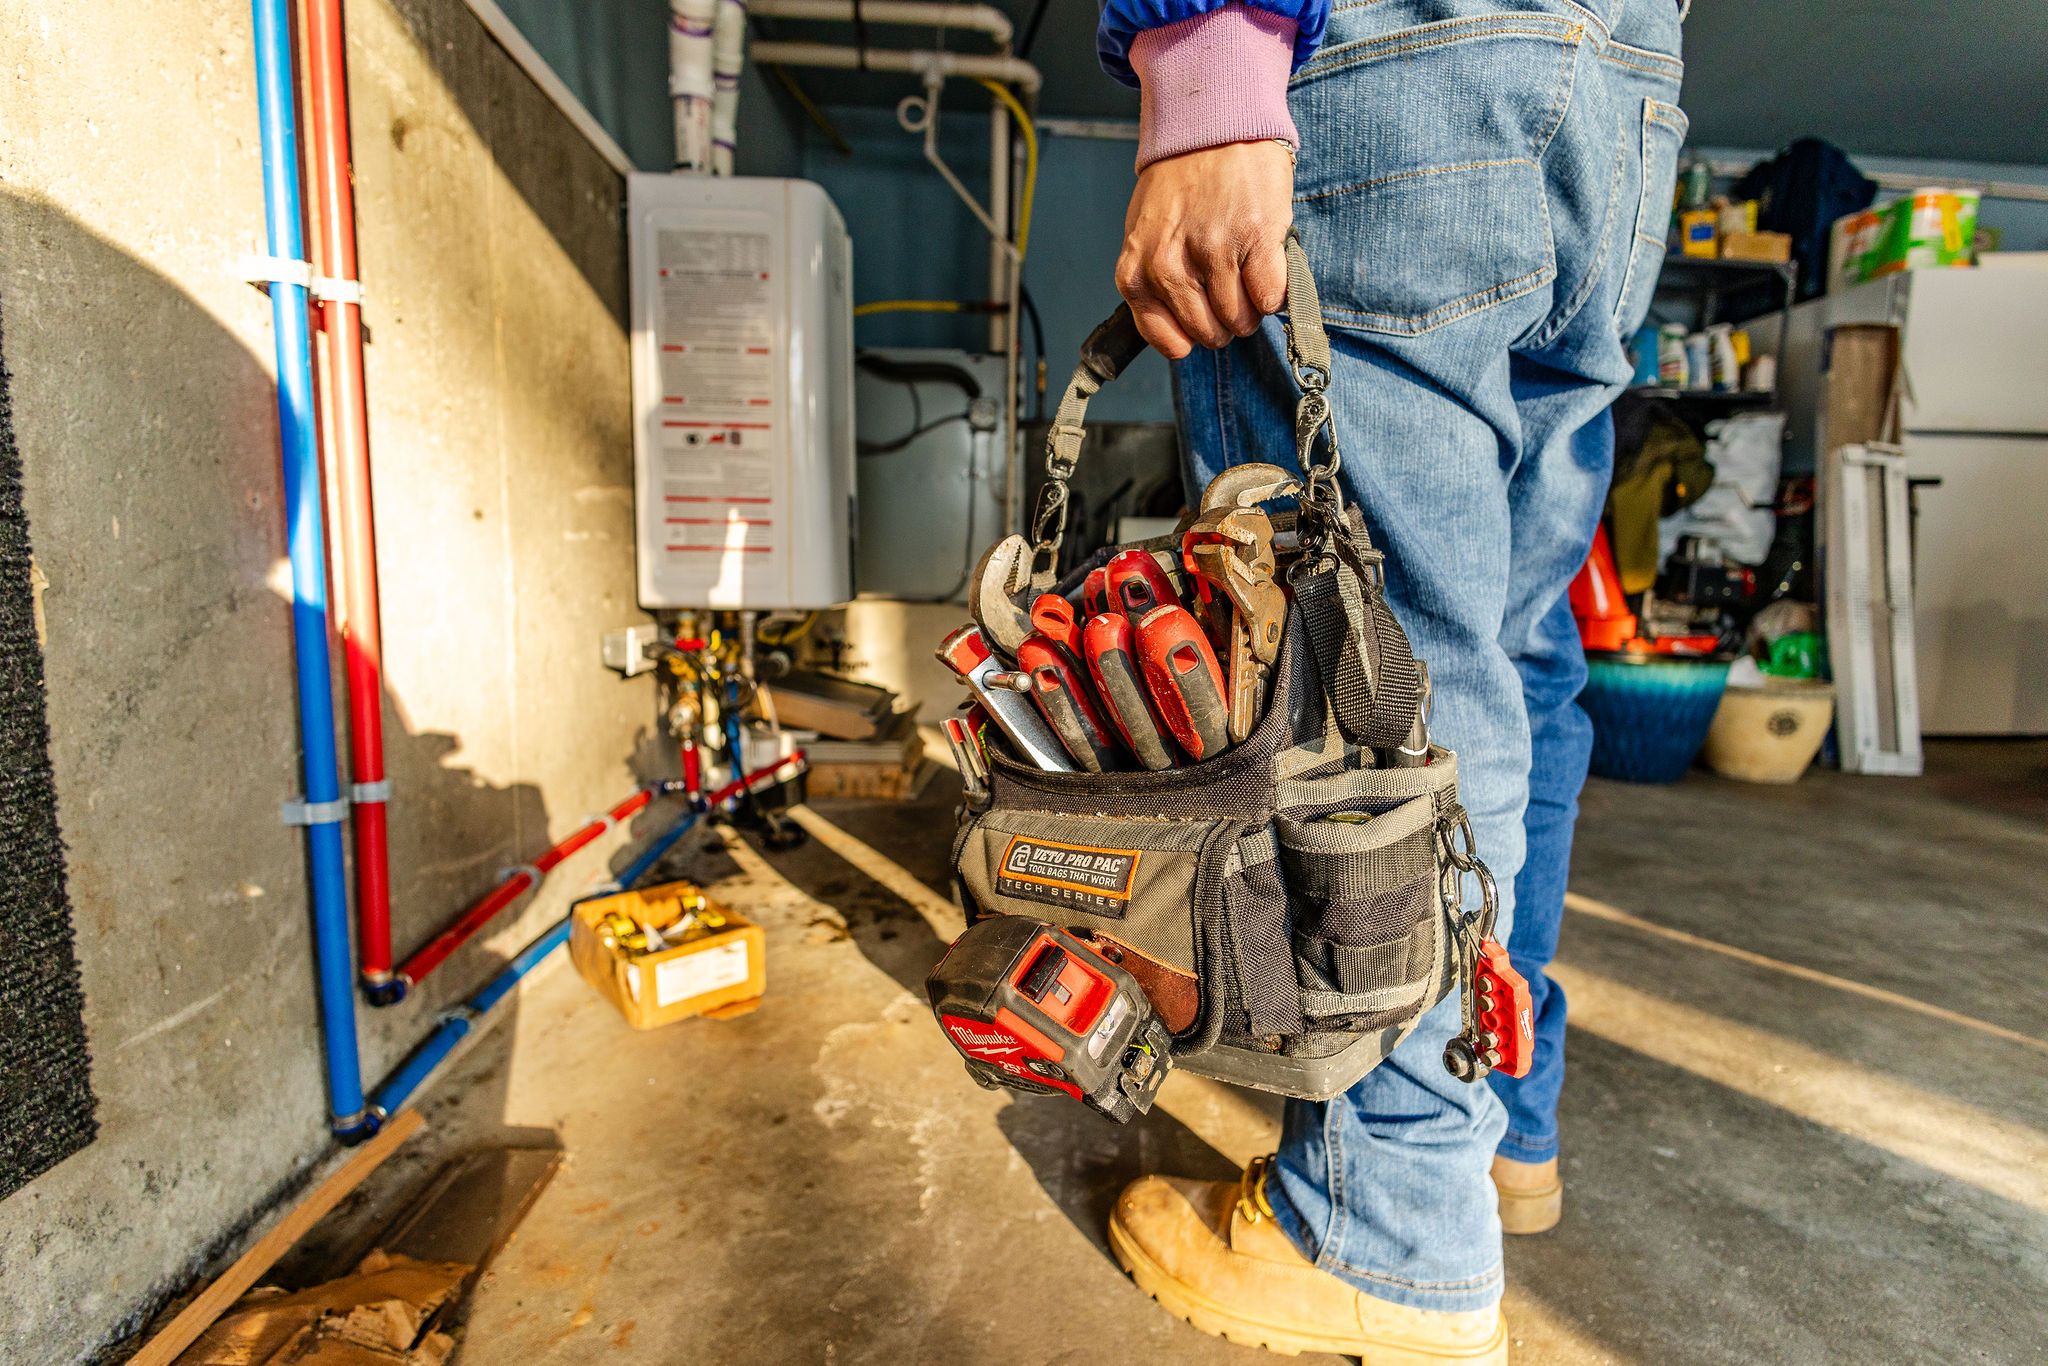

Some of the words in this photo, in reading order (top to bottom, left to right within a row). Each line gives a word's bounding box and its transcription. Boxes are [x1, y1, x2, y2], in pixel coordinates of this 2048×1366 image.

[1033, 848, 1065, 863] VETO
[1064, 853, 1093, 868] PRO
[1029, 864, 1046, 875] TOOL
[1047, 867, 1068, 879] BAGS
[1070, 870, 1089, 882] THAT
[1091, 874, 1117, 888] WORK
[1006, 879, 1043, 893] TECH
[1051, 888, 1118, 907] SERIES
[950, 1025, 1018, 1045] Milwaukee
